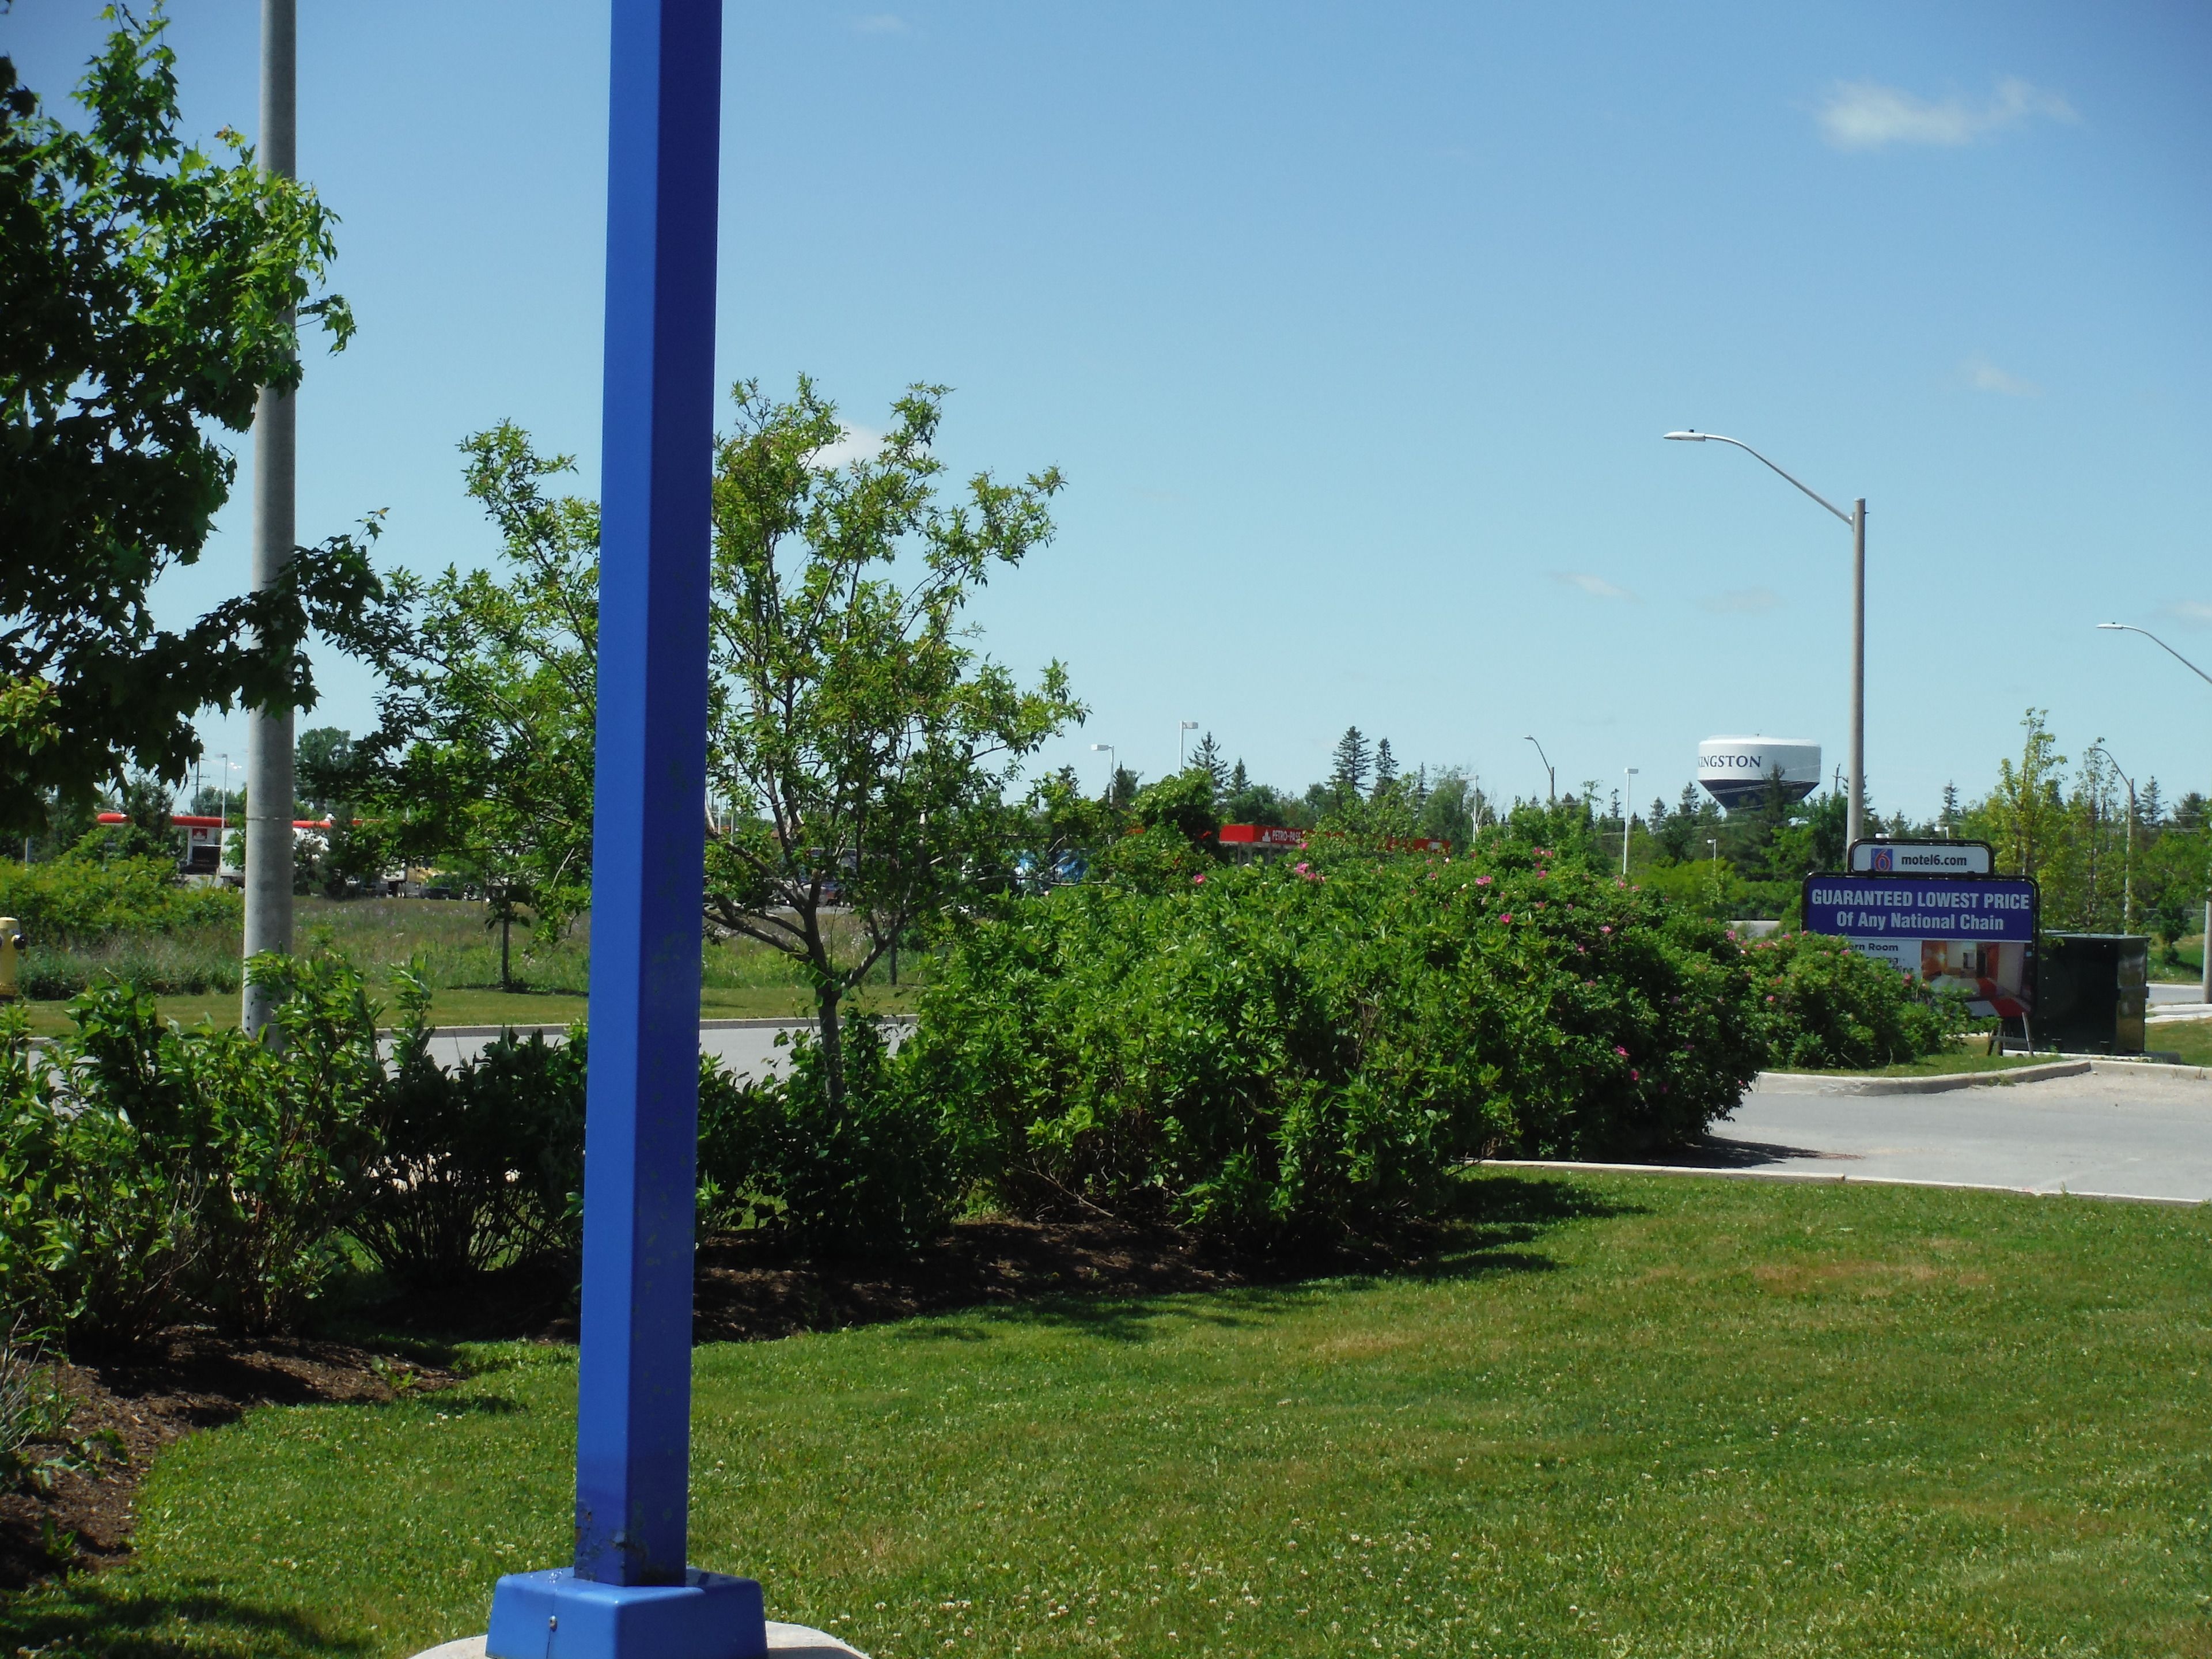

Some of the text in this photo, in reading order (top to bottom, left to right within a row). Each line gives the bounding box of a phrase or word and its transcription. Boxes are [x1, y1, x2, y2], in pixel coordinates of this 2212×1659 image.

[1902, 854, 1967, 866] motel6.com
[1812, 889, 2030, 910] GUARANTEED LOWEST PRICE
[1836, 911, 2004, 931] Of Any National Chain
[1868, 942, 1899, 951] Room
